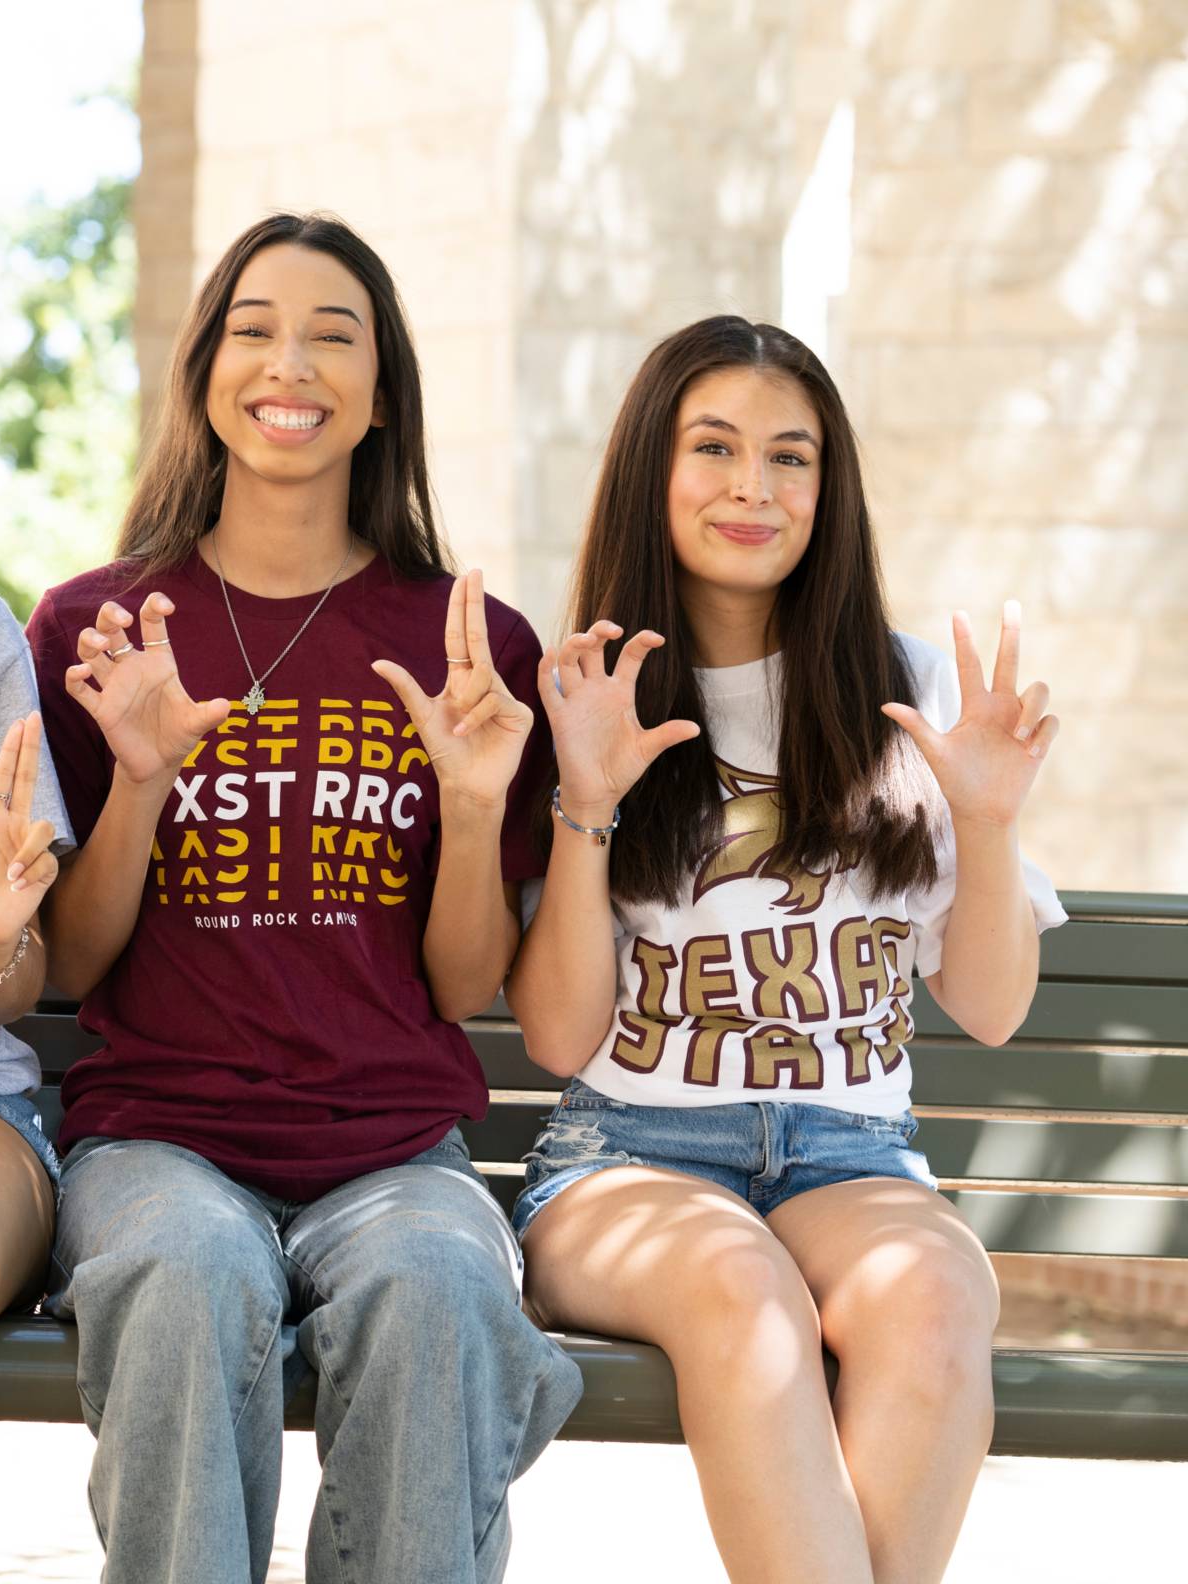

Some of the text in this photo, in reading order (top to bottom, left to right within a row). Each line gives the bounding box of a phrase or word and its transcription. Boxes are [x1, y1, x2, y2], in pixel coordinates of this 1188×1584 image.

[173, 770, 423, 829] XST RRC
[195, 915, 240, 928] ROUND
[253, 913, 298, 926] ROCK
